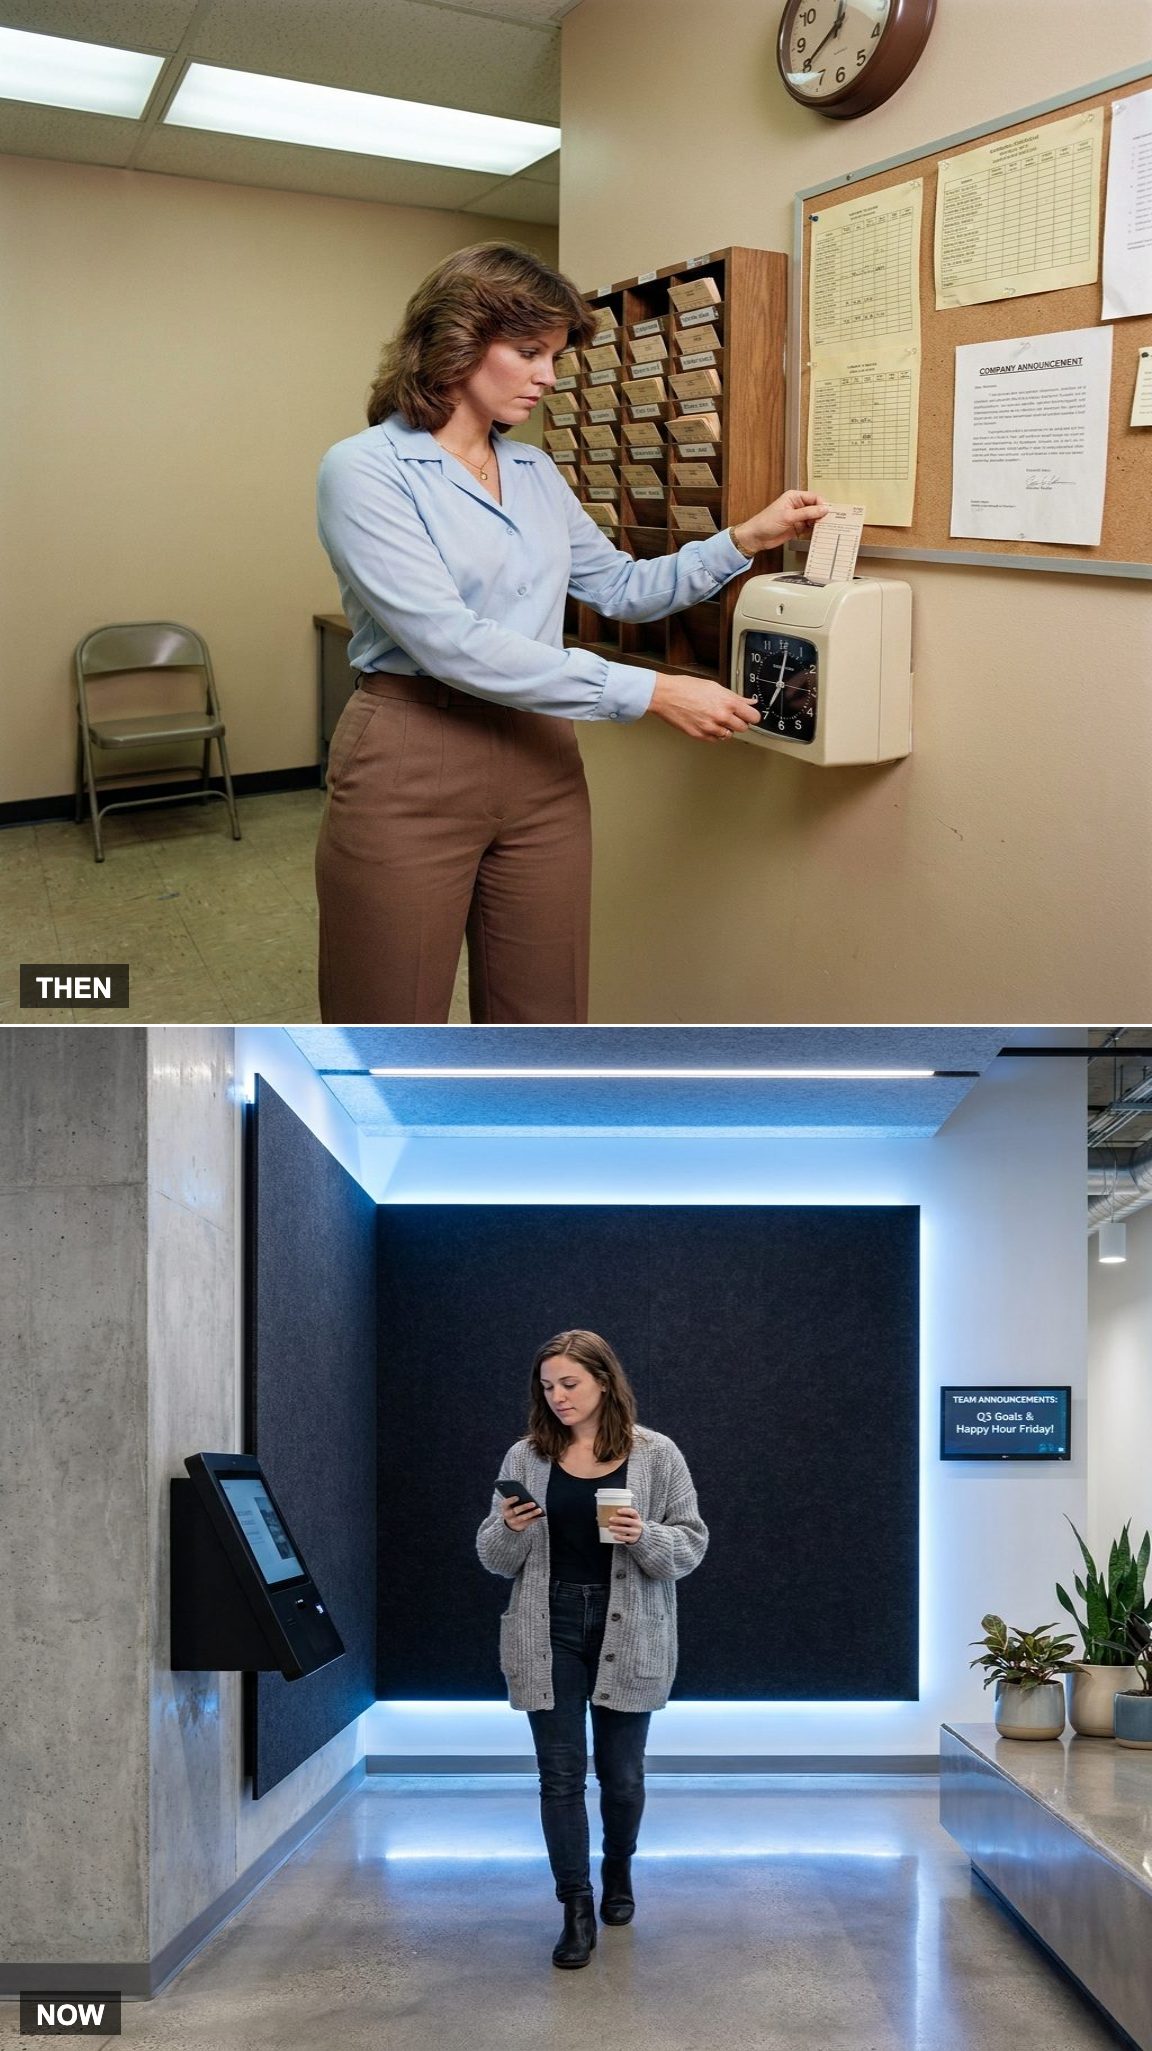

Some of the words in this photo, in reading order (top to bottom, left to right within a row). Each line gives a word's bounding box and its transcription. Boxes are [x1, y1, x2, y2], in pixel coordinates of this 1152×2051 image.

[799, 8, 817, 27] 10
[870, 22, 881, 39] 4
[797, 37, 806, 53] 9
[856, 49, 867, 67] 5
[802, 58, 812, 73] 8
[817, 69, 826, 86] 7
[835, 66, 846, 83] 6
[979, 364, 1016, 375] COMPANY
[751, 653, 761, 663] 10
[809, 664, 817, 674] 2
[749, 673, 756, 683] 9
[762, 710, 769, 720] 7
[806, 707, 814, 718] 4
[777, 720, 785, 731] 6
[953, 1395, 977, 1404] TEAM
[978, 1395, 1058, 1404] ANNOUNCEMENTS:
[994, 1411, 1023, 1421] Goals
[1025, 1411, 1035, 1421] &
[956, 1424, 989, 1436] Happy
[991, 1424, 1017, 1433] Hour
[1019, 1424, 1054, 1436] Friday!
